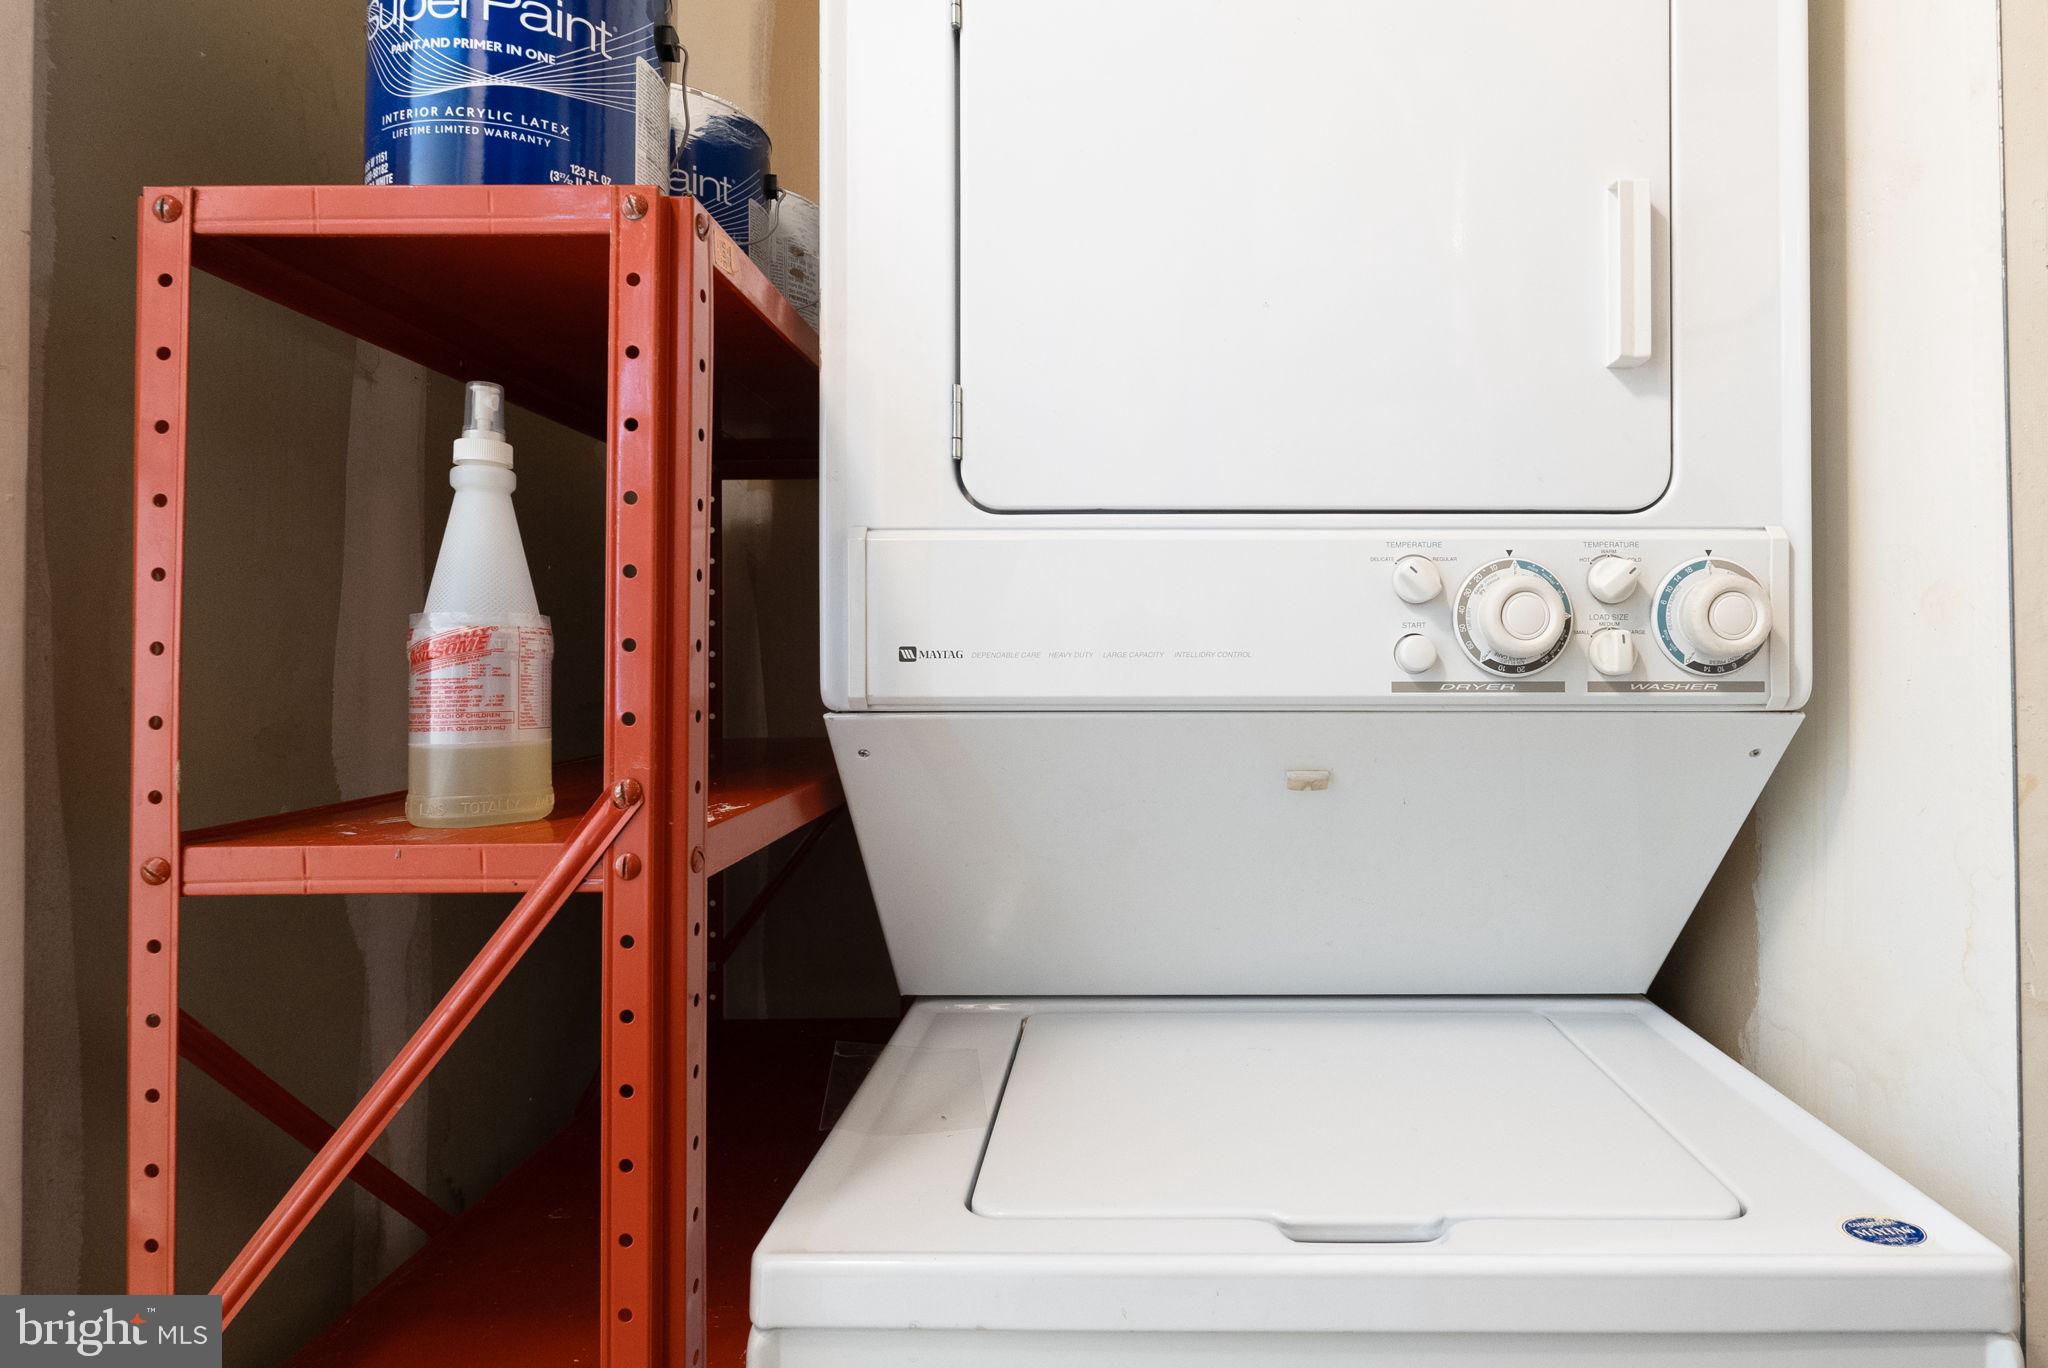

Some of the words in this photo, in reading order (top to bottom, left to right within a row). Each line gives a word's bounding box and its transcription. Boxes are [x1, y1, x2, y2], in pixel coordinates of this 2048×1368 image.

[391, 39, 421, 55] PAINT
[422, 37, 450, 48] AND
[453, 37, 503, 53] PRIMER
[506, 44, 522, 56] IN
[525, 48, 556, 65] ONE
[381, 106, 438, 126] INTERIOR
[445, 106, 513, 122] ACRYLIC
[521, 115, 570, 136] LATEX
[392, 126, 431, 139] LIFETIME
[435, 125, 480, 135] LIMITED
[483, 127, 551, 148] WARRANTY
[570, 164, 586, 177] 123
[588, 170, 599, 182] FL
[670, 165, 733, 206] aint
[1473, 573, 1483, 583] 20
[1673, 574, 1682, 583] 14
[1463, 588, 1472, 598] 30
[1665, 585, 1673, 594] 10
[1458, 605, 1466, 615] 40
[1589, 613, 1610, 621] LOAD
[919, 650, 964, 659] MAYTAG
[971, 651, 1019, 659] DEPENDABLE
[1021, 651, 1041, 659] CARE
[1048, 651, 1073, 659] HEAVY
[1074, 651, 1094, 659] DUTY
